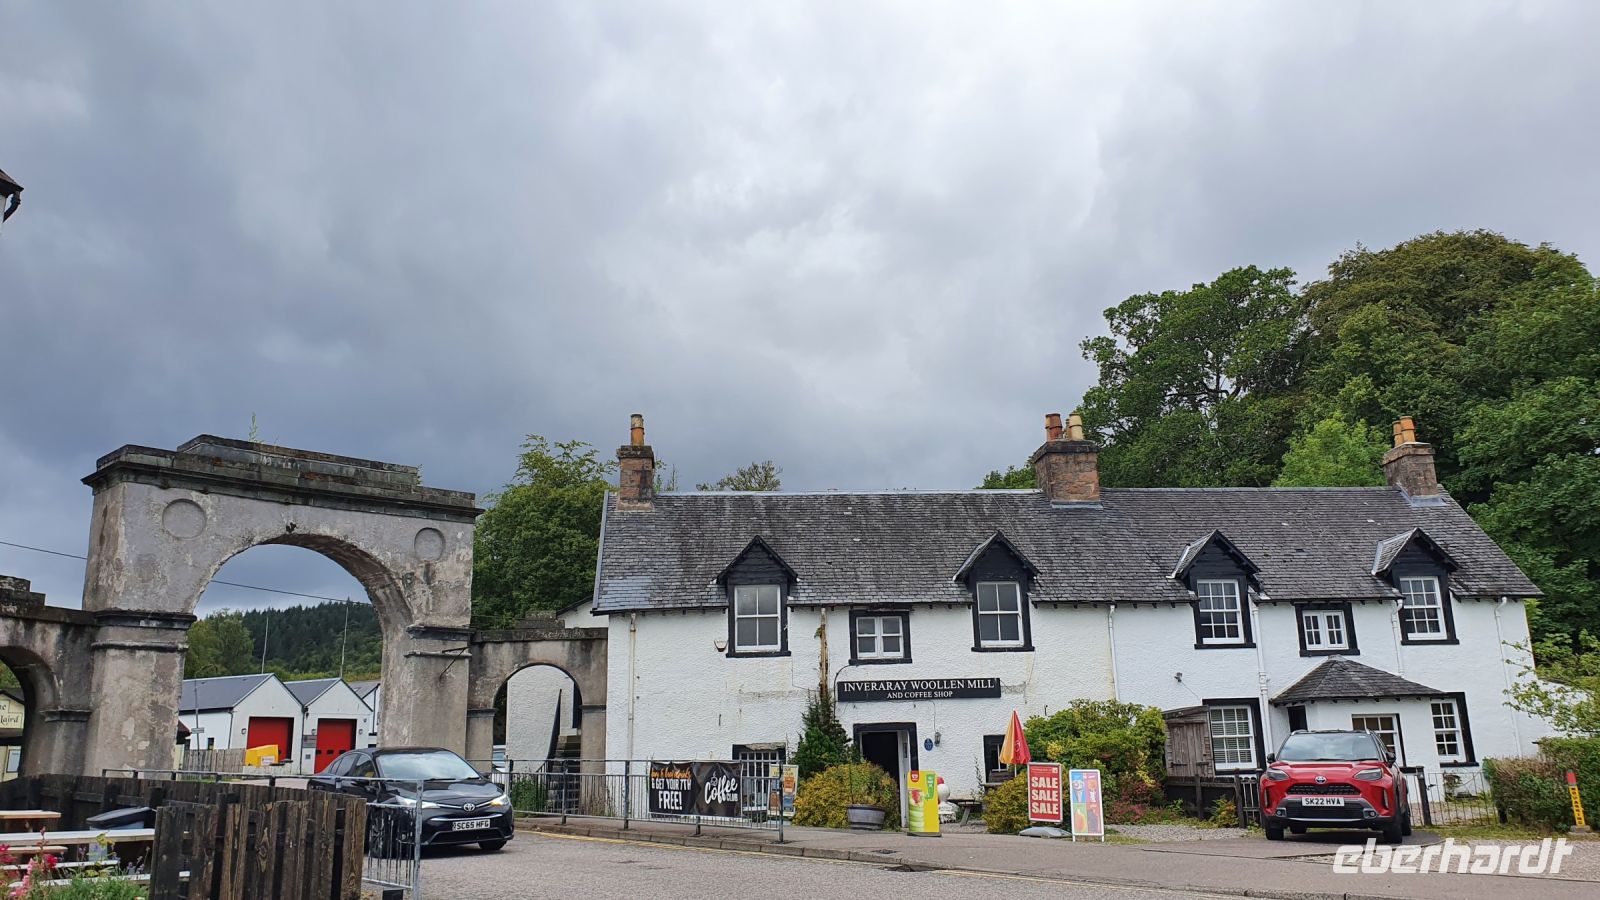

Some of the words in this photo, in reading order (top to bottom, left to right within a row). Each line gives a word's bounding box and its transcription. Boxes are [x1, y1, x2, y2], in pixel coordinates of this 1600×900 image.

[844, 680, 908, 692] INVERARAY
[910, 679, 966, 690] WOOLLEN
[967, 679, 994, 689] MILL
[904, 691, 932, 699] COFFEE
[656, 778, 665, 790] GET
[666, 778, 680, 790] YOUR
[1031, 776, 1058, 788] SALE
[704, 775, 738, 805] Coffee
[1031, 789, 1058, 801] SALE
[658, 791, 683, 810] FREE!
[1031, 802, 1059, 814] SALE
[457, 821, 475, 829] SC65
[476, 820, 489, 828] HFG
